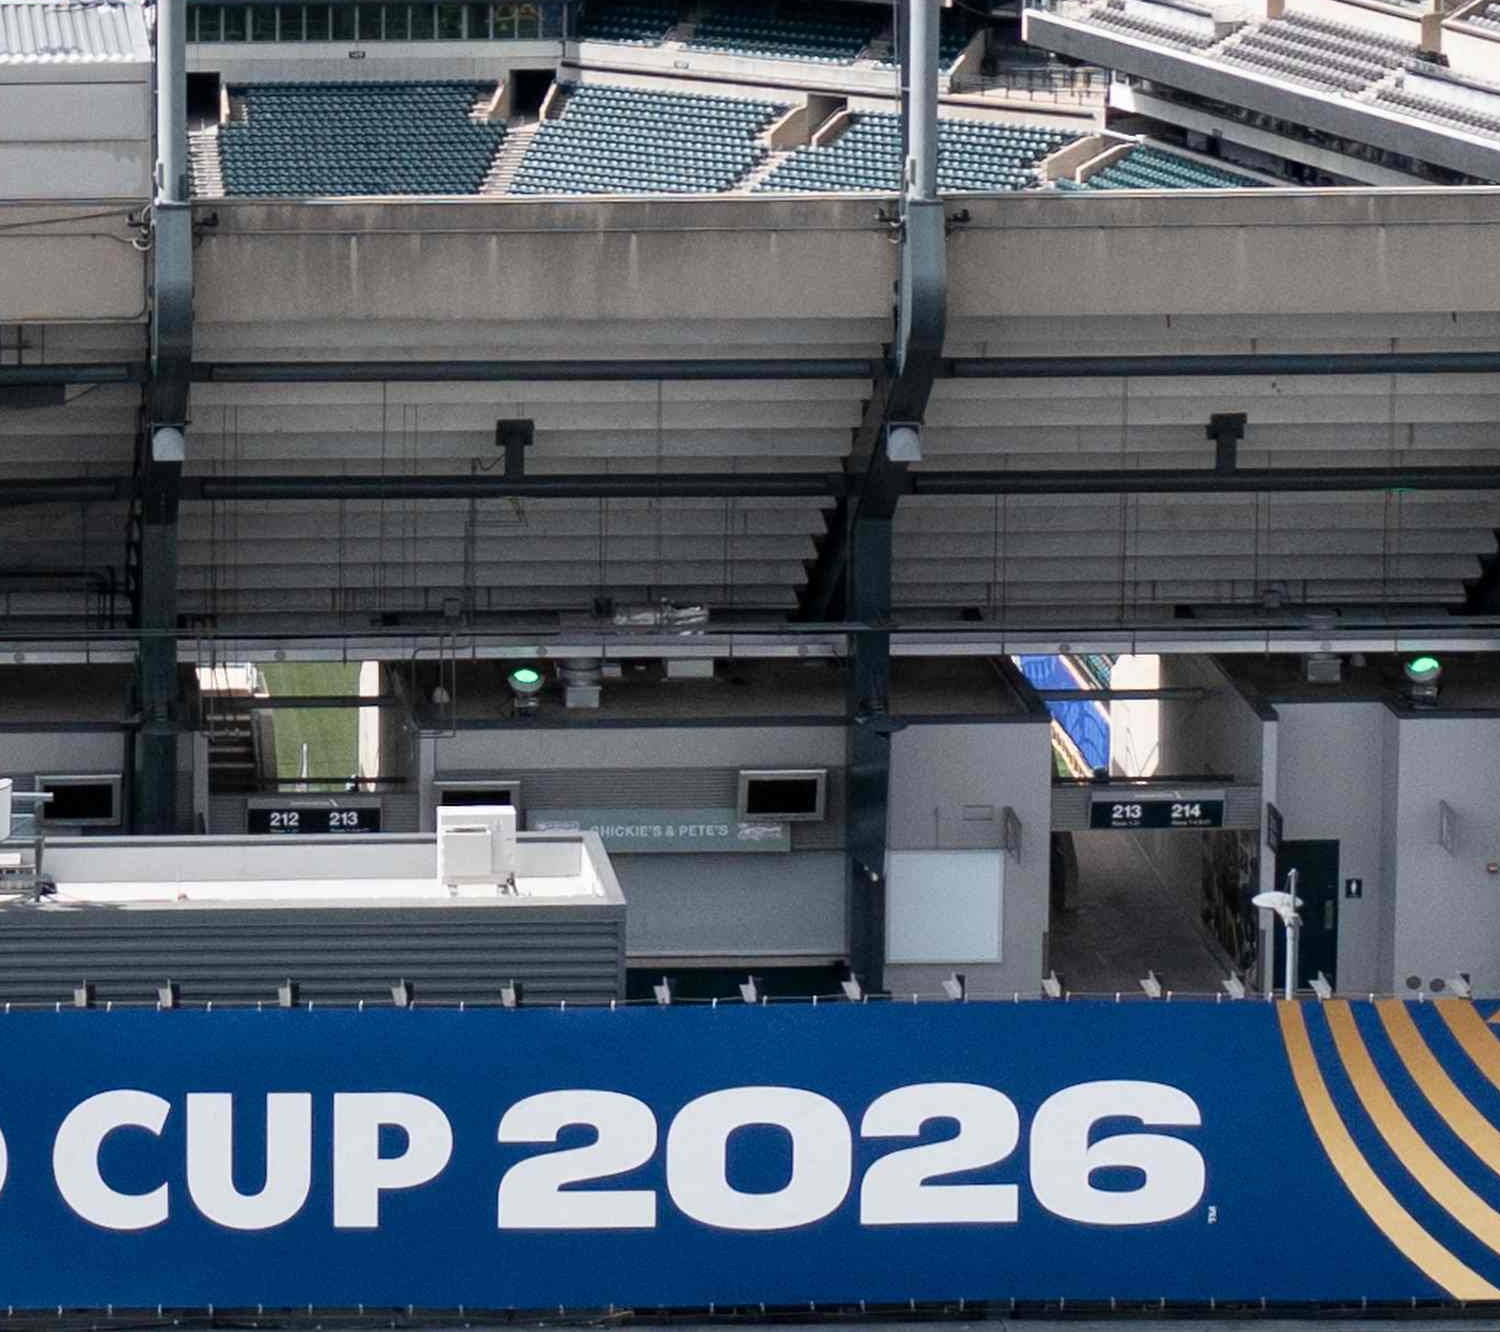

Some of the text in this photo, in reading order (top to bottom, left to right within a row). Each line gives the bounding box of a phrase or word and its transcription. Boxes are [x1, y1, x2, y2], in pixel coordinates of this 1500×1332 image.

[269, 811, 360, 827] 212 213
[1111, 803, 1202, 819] 213 214
[679, 824, 729, 837] PETE'S
[51, 1088, 454, 1231] CUP
[496, 1079, 1206, 1232] 2026
